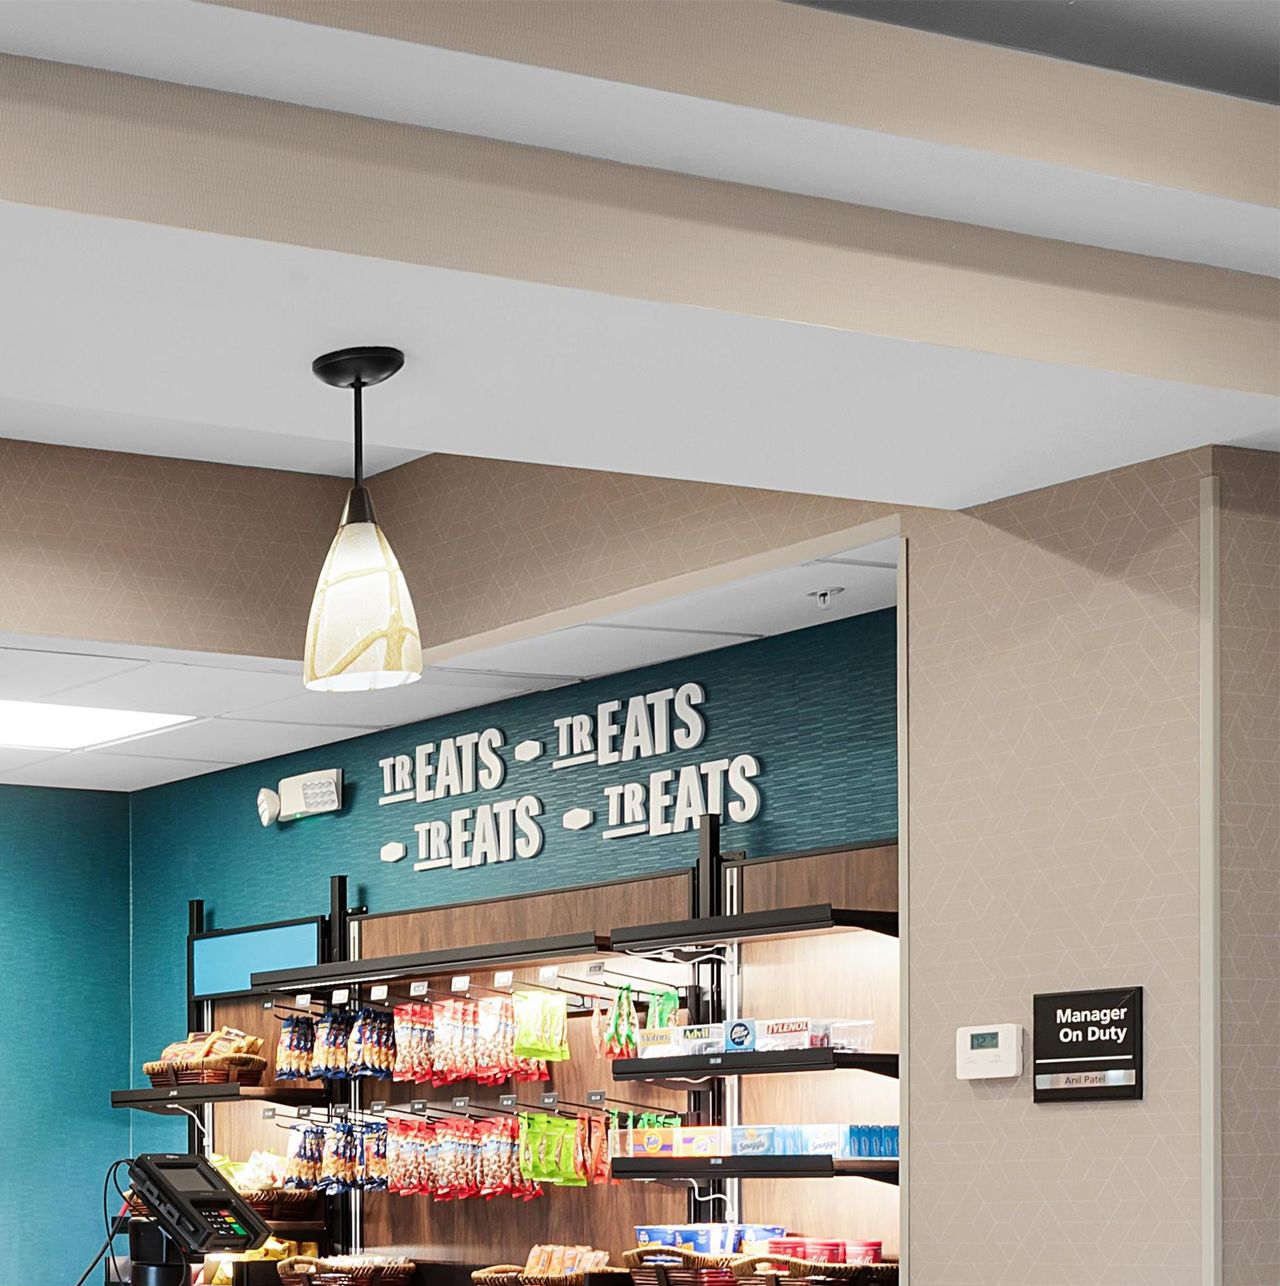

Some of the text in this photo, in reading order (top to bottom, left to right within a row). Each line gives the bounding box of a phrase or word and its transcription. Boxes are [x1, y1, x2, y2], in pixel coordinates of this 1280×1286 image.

[378, 682, 706, 806] TREATS TREATS
[413, 754, 761, 871] TREATS TREATS
[1056, 1006, 1128, 1025] Manager
[685, 1028, 709, 1040] Advil
[768, 1021, 808, 1034] TYLENOL
[1058, 1026, 1128, 1044] On Duty
[1064, 1074, 1106, 1085] Anil Patel
[646, 1136, 659, 1147] Tide
